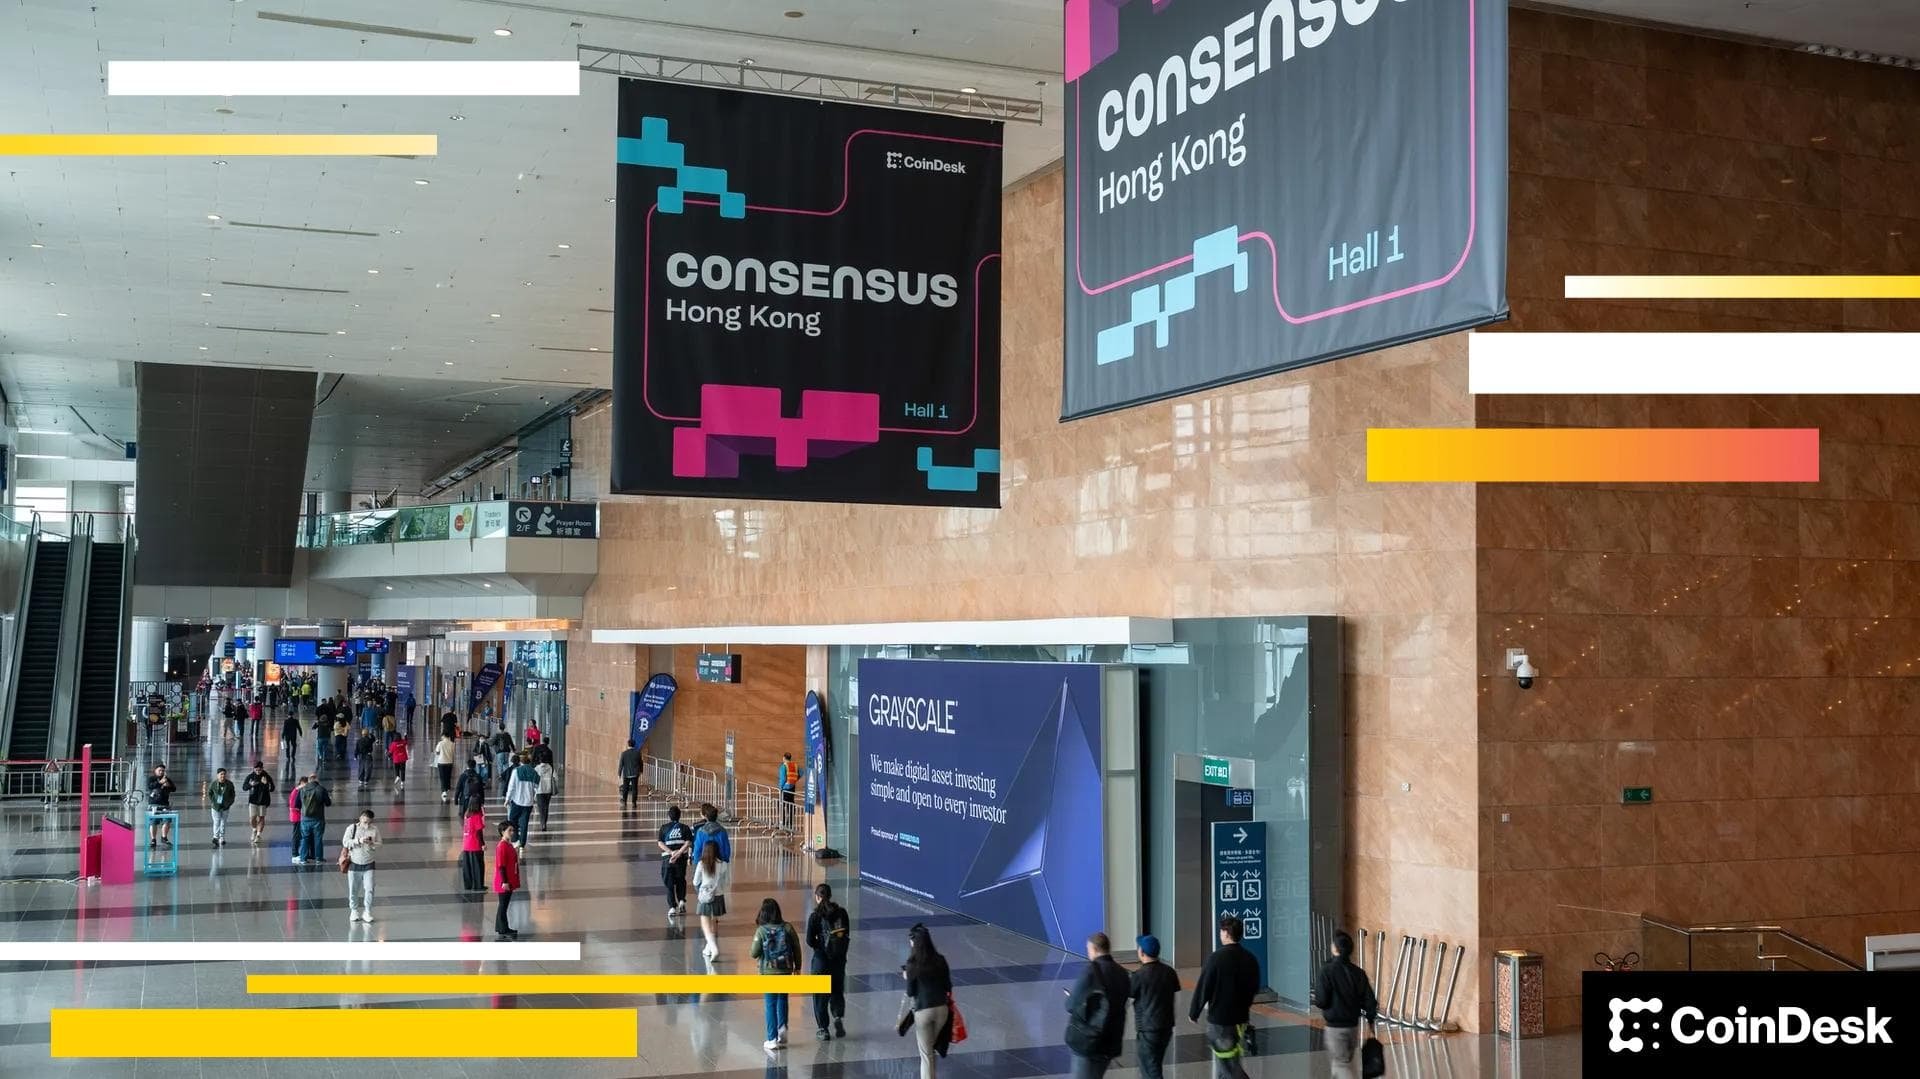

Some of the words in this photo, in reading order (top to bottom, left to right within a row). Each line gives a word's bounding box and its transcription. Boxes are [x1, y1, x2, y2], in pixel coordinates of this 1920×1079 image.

[1098, 0, 1407, 152] CONSENS
[904, 155, 967, 175] CoinDesk
[1098, 152, 1164, 215] Hong
[1171, 112, 1247, 182] Kong
[1329, 230, 1379, 281] Hall
[1386, 225, 1404, 263] 1
[666, 252, 958, 308] CONSENSUS
[666, 298, 742, 332] Hong
[750, 304, 821, 337] Kong
[904, 402, 934, 418] Hall
[938, 404, 949, 419] 1
[516, 524, 531, 532] 2/F
[556, 519, 574, 527] Prayer
[575, 519, 592, 527] Room
[870, 753, 882, 773] We
[883, 758, 904, 777] make
[904, 760, 930, 784] digital
[931, 767, 953, 786] asset
[955, 768, 997, 799] investing
[1204, 765, 1217, 777] EXIT
[1217, 767, 1228, 778] 出口
[870, 778, 895, 802] simple
[895, 785, 911, 803] and
[912, 790, 932, 810] open
[934, 794, 943, 810] to
[944, 797, 968, 820] every
[969, 797, 1007, 824] investor
